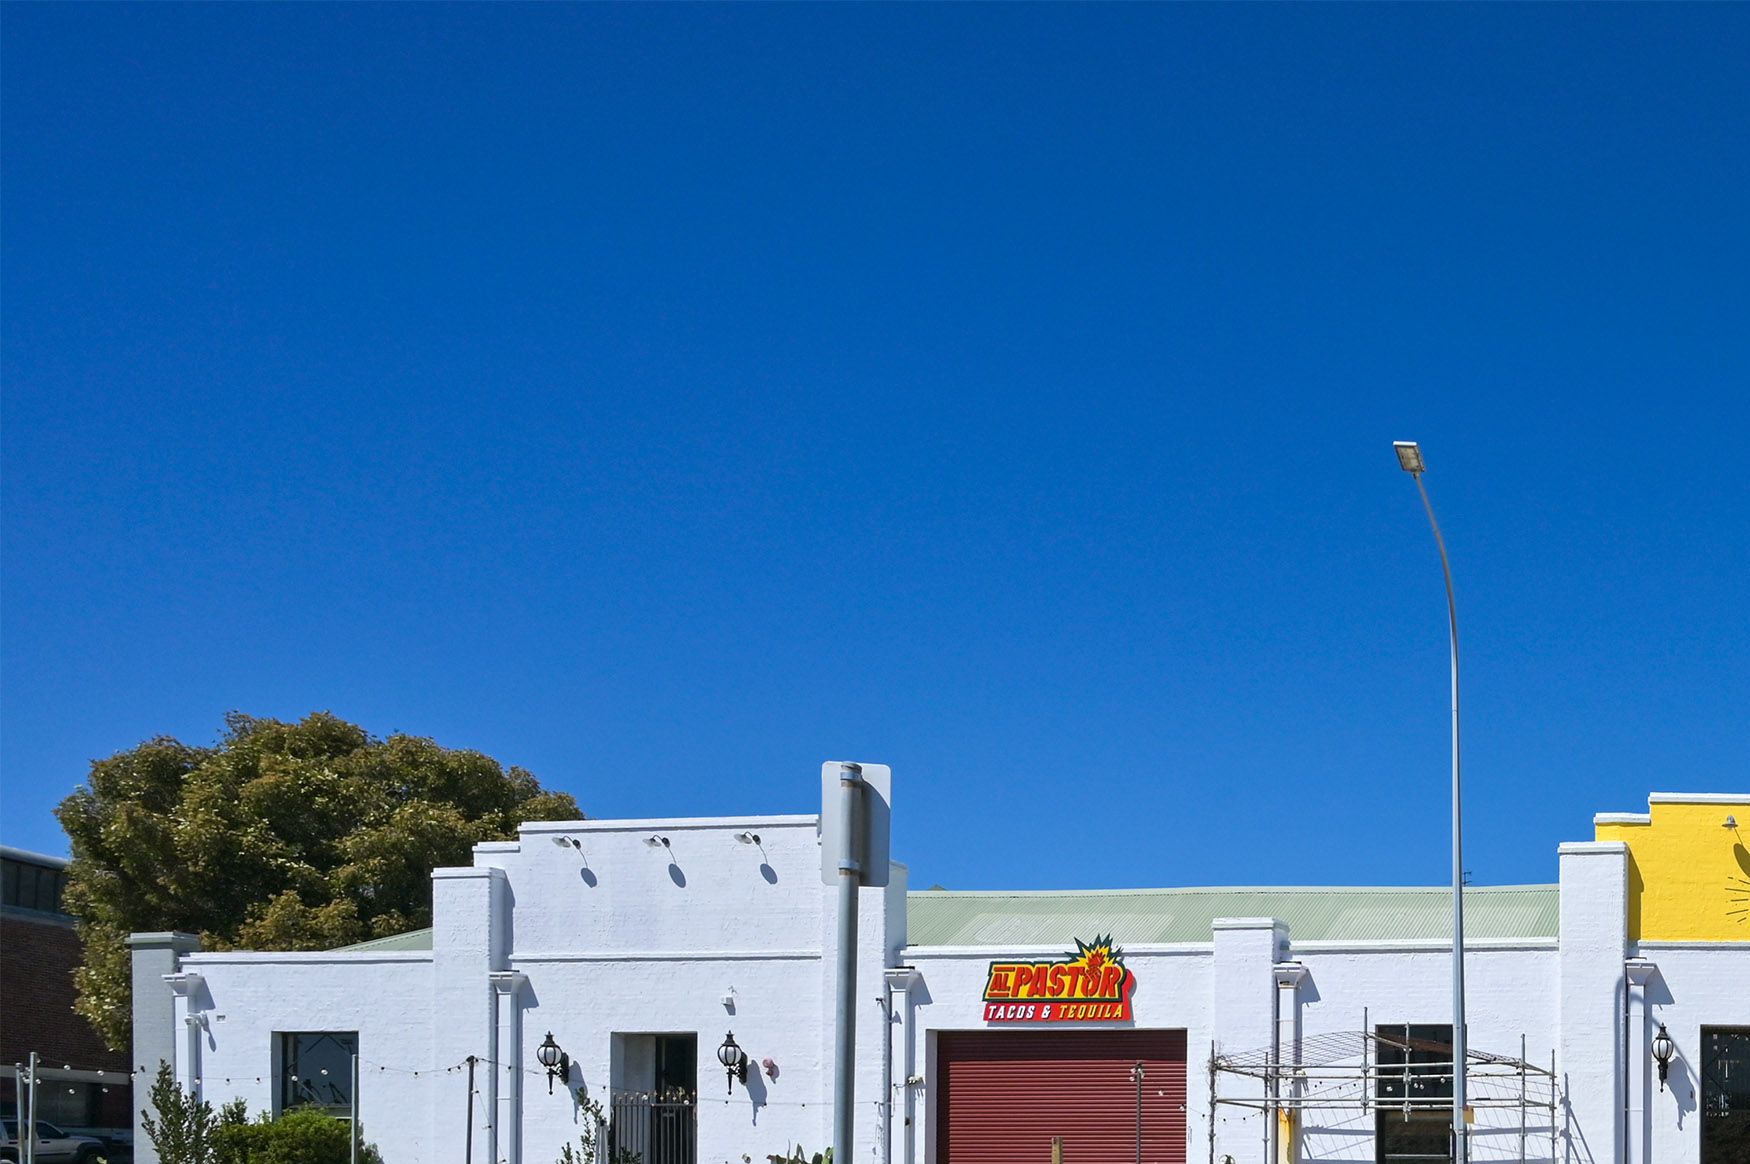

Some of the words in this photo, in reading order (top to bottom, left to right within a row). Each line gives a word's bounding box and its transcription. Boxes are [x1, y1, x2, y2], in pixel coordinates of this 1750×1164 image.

[989, 972, 1011, 992] AL
[1011, 965, 1124, 998] PASTOR
[988, 1005, 1036, 1019] TACOS
[1041, 1005, 1051, 1019] &
[1059, 1005, 1123, 1019] TEQUILA
